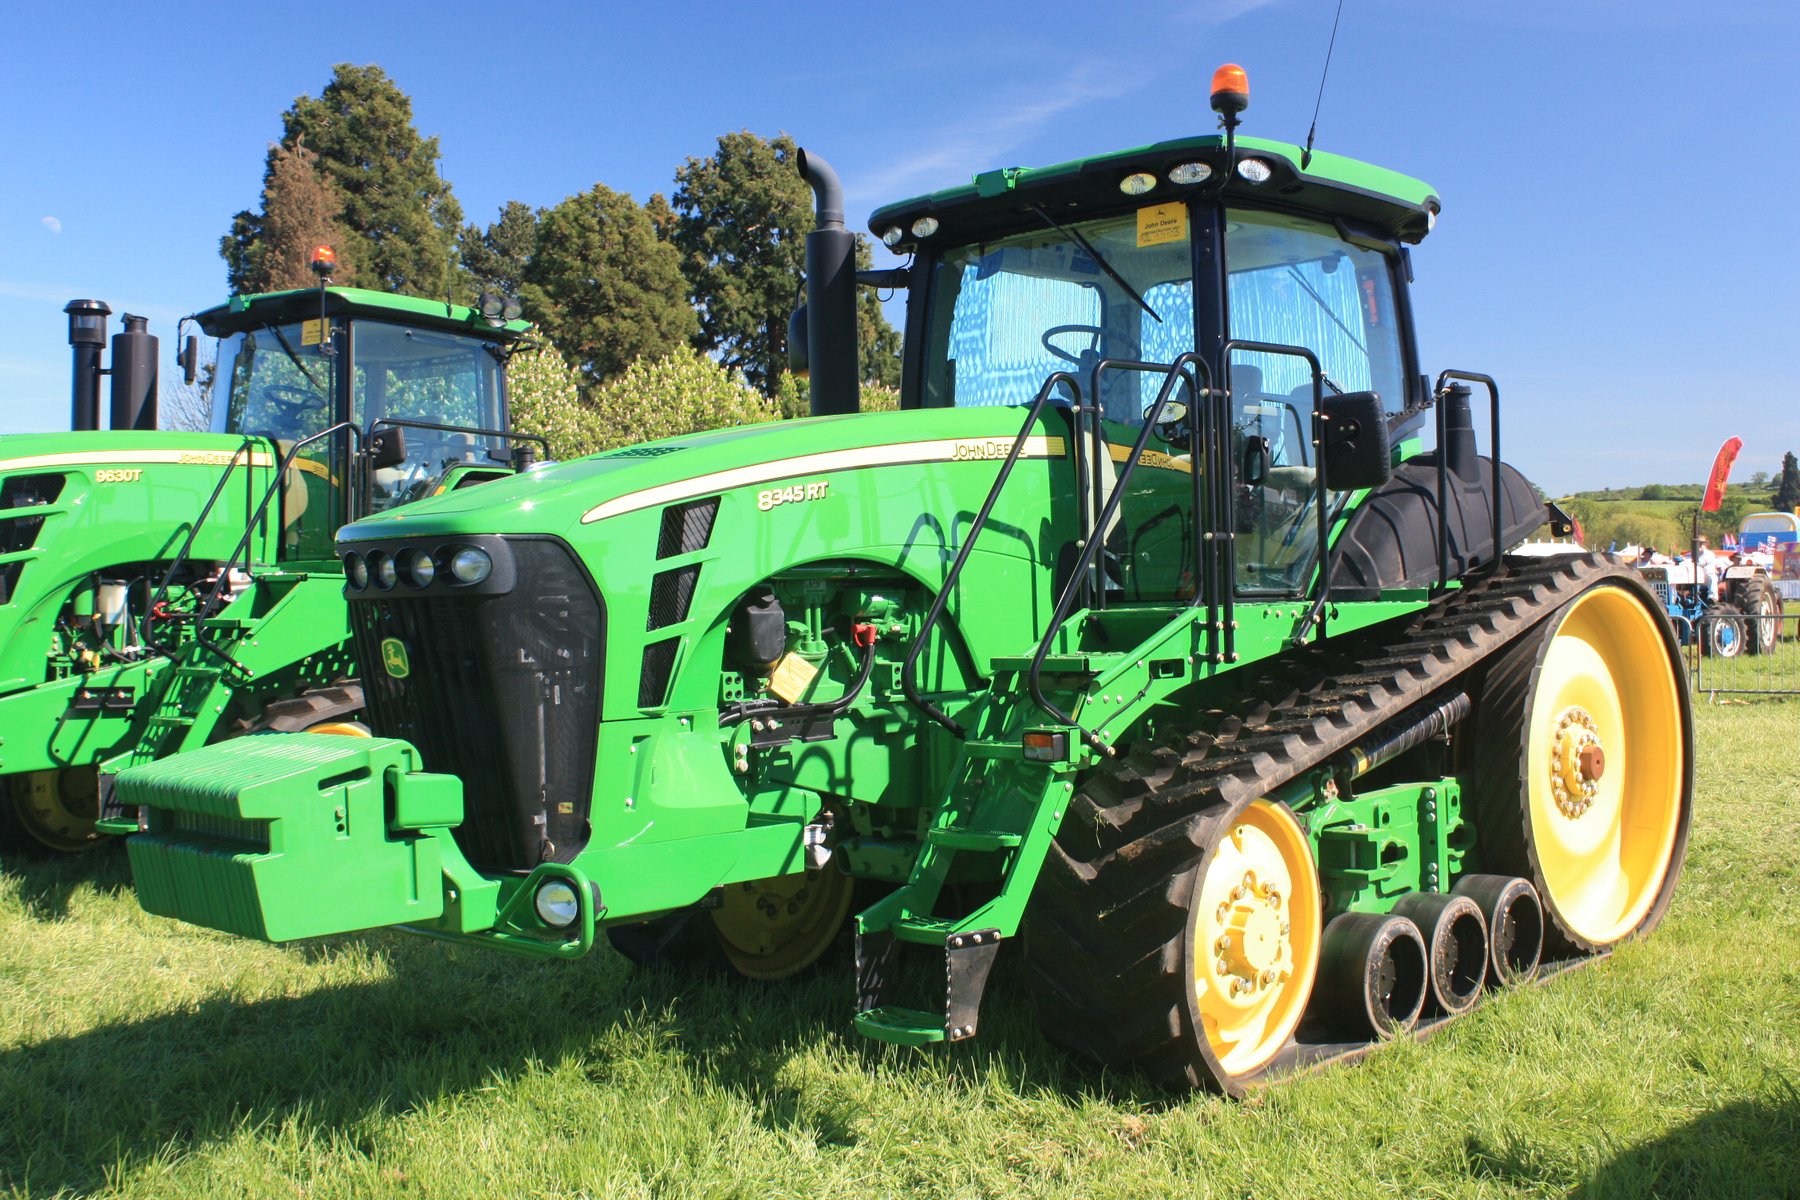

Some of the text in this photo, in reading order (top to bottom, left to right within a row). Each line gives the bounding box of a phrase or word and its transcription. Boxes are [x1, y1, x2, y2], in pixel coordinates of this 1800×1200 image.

[96, 469, 144, 483] 9630T
[757, 481, 829, 512] 8345 RT
